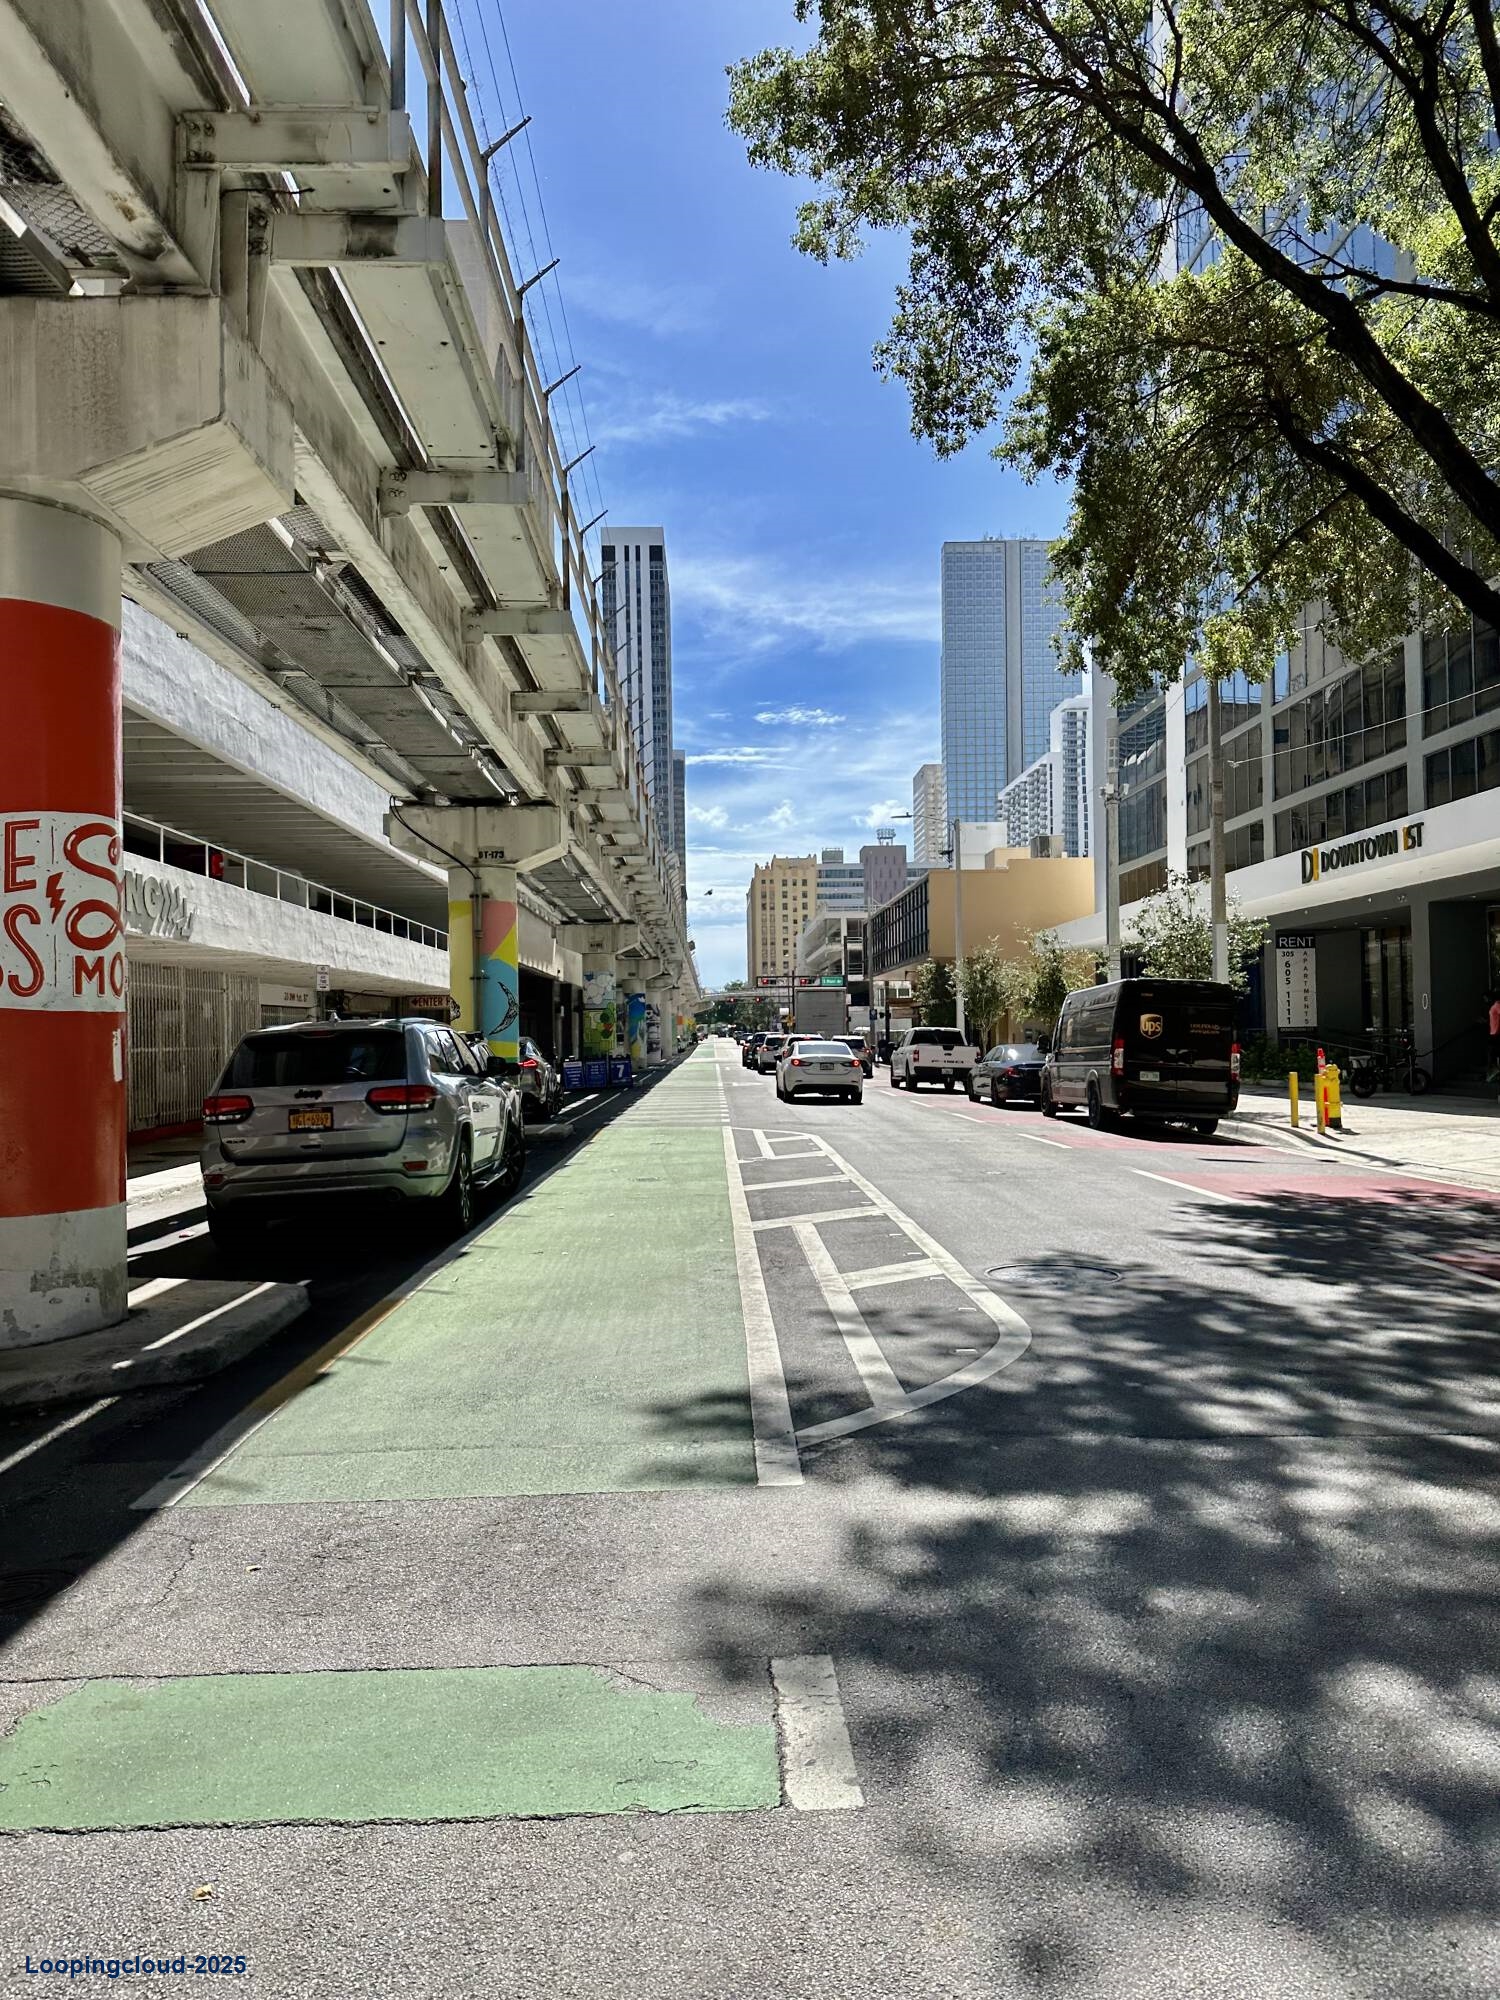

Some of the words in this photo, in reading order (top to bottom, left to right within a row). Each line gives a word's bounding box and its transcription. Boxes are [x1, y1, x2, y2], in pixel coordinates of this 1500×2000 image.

[1321, 830, 1398, 872] DOWNTOWN
[1279, 937, 1314, 948] RENT
[420, 997, 442, 1007] ENTER
[1143, 1021, 1161, 1035] ups
[617, 1065, 625, 1078] 7
